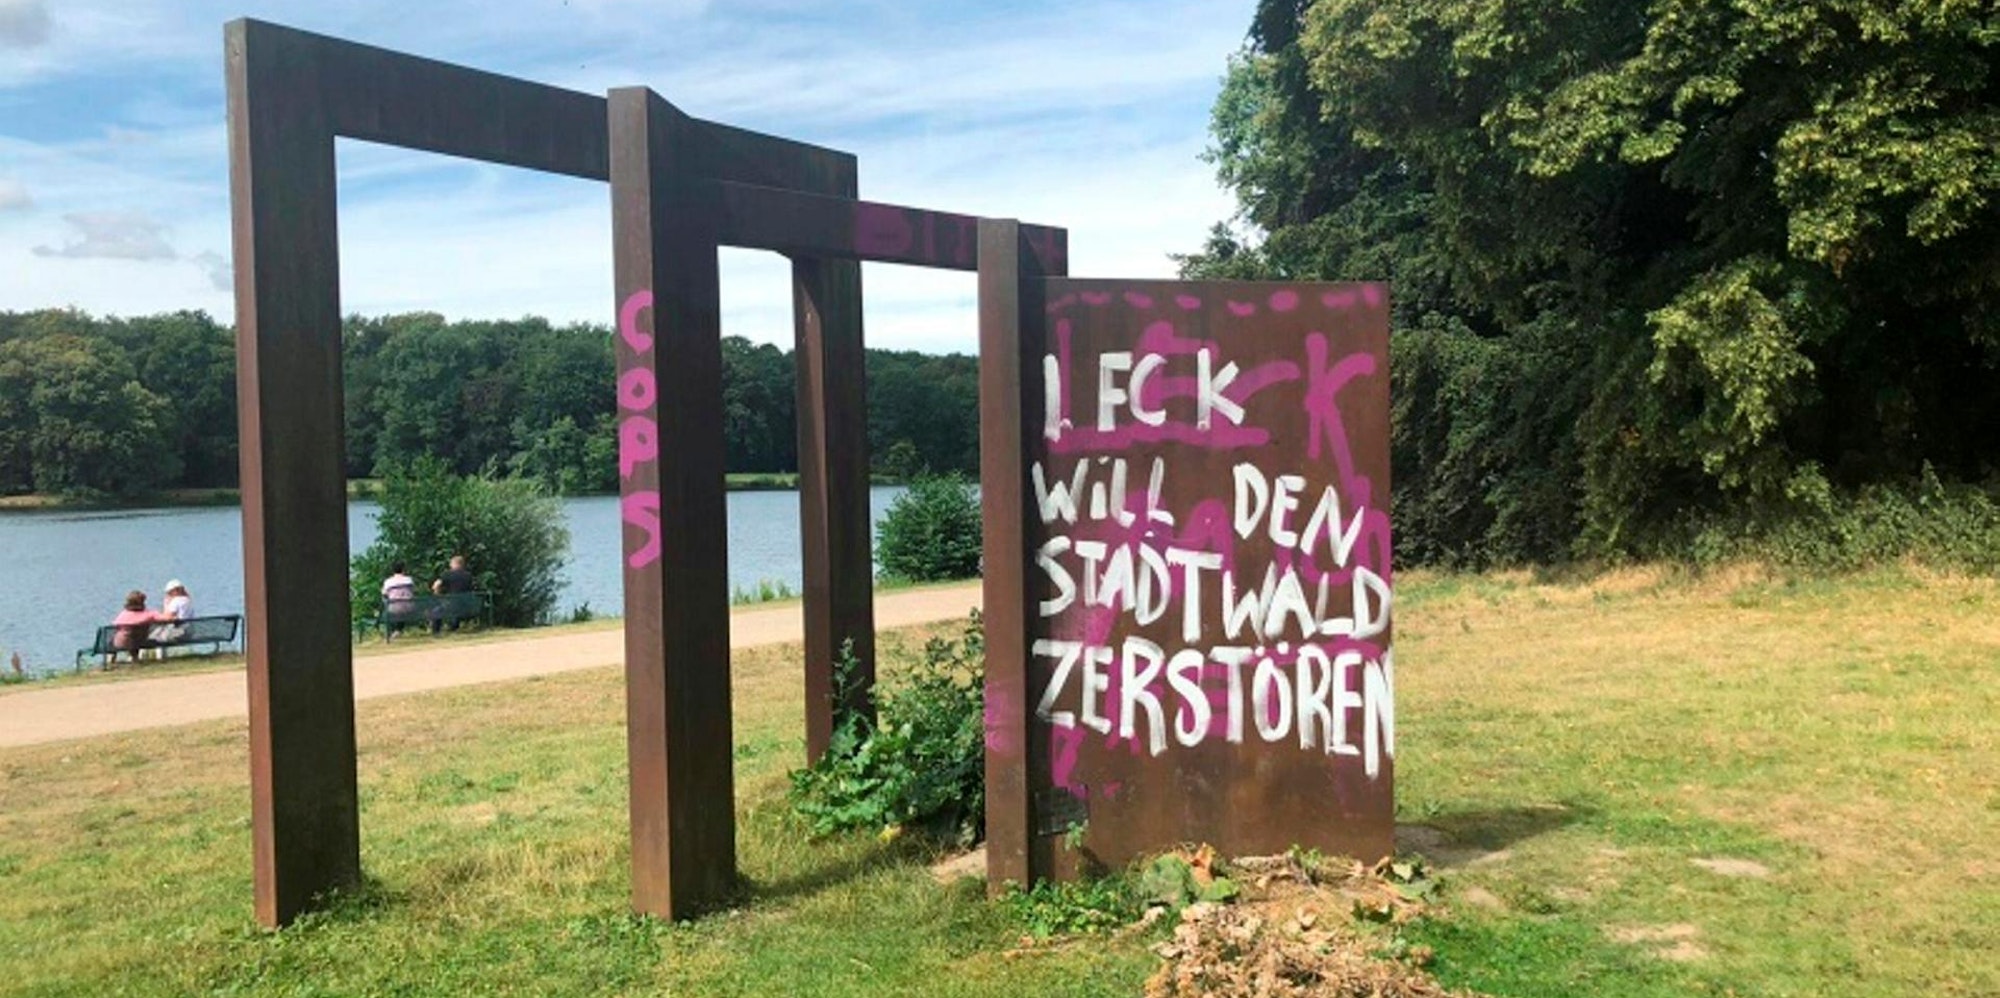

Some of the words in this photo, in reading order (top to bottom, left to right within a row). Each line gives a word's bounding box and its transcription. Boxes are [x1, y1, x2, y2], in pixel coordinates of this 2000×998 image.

[618, 290, 662, 570] COPS
[1232, 462, 1364, 568] DEN
[1035, 536, 1392, 643] STADTWALD
[1032, 636, 1394, 780] ZERSTÖREN
